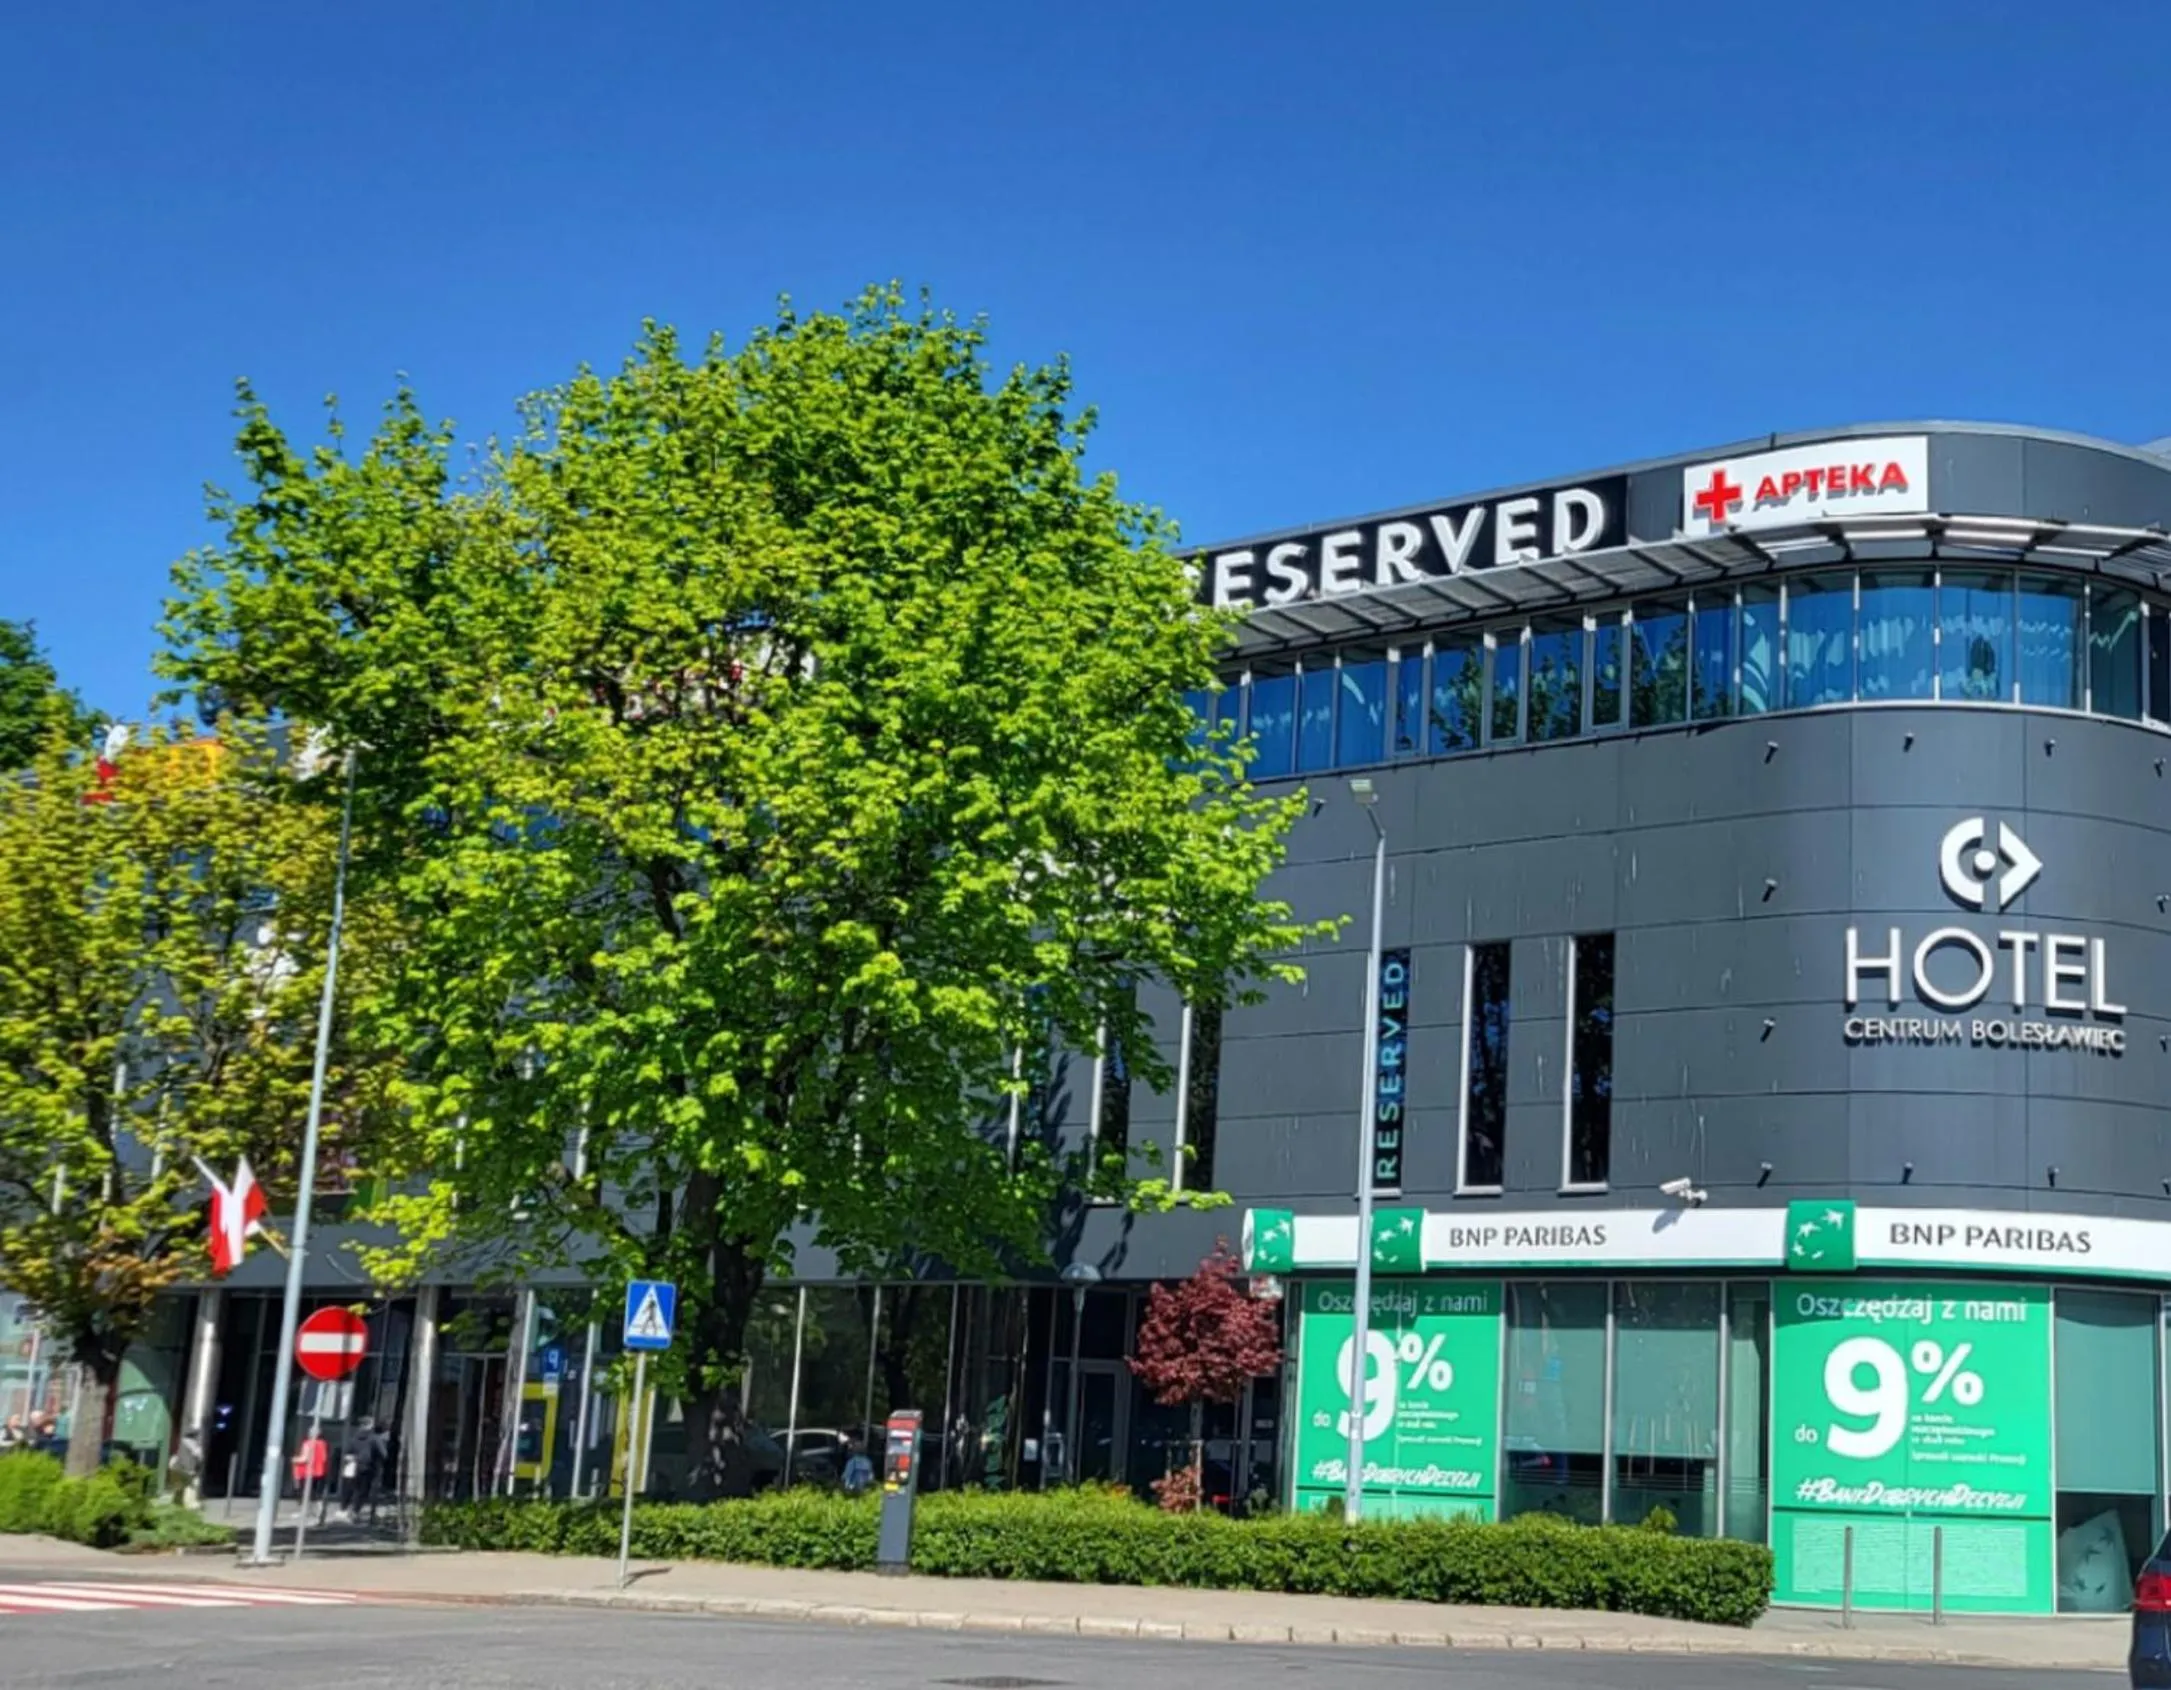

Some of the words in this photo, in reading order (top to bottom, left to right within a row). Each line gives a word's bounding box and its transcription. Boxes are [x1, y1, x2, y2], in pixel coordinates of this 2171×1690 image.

[1756, 461, 1909, 502] APTEKA
[1184, 488, 1607, 614] ESERVED
[1846, 926, 2127, 1014] HOTEL
[1844, 1017, 1963, 1041] CENTRUM
[1376, 962, 1405, 1180] RESERVED
[1450, 1227, 1498, 1248] BNP
[1504, 1224, 1607, 1247] PARIBAS
[1890, 1222, 1956, 1246] BNP
[1965, 1225, 2092, 1254] PARIBAS
[1424, 1297, 1434, 1313] z
[1440, 1291, 1488, 1313] nami
[1797, 1292, 1933, 1325] Oszczędzaj
[1941, 1299, 1957, 1320] z
[1965, 1297, 2028, 1322] nami
[1312, 1409, 1332, 1428] do
[1794, 1424, 1818, 1443] do
